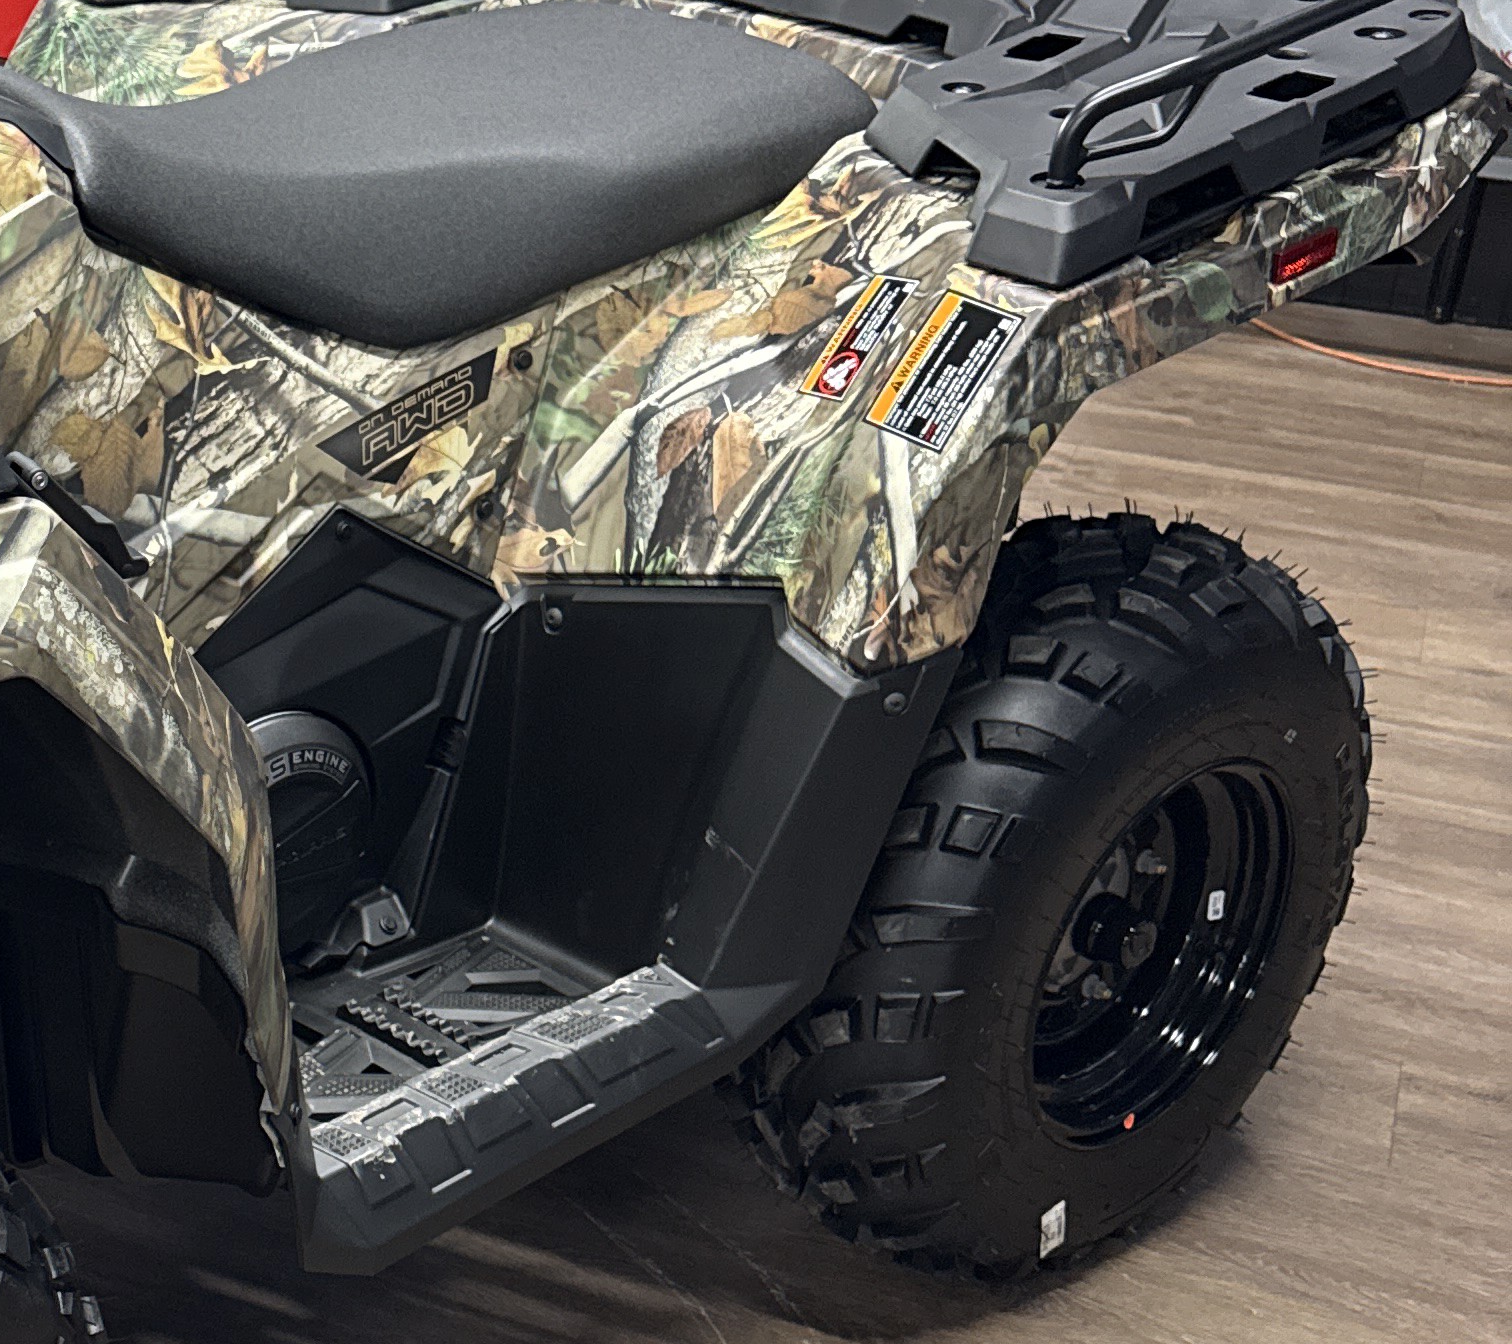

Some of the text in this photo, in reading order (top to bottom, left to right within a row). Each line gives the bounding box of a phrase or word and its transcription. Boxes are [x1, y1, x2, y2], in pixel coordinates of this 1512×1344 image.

[898, 322, 941, 379] WARNING
[358, 365, 473, 434] ON DEMAND
[361, 379, 475, 466] AWD
[291, 749, 349, 774] ENGINE
